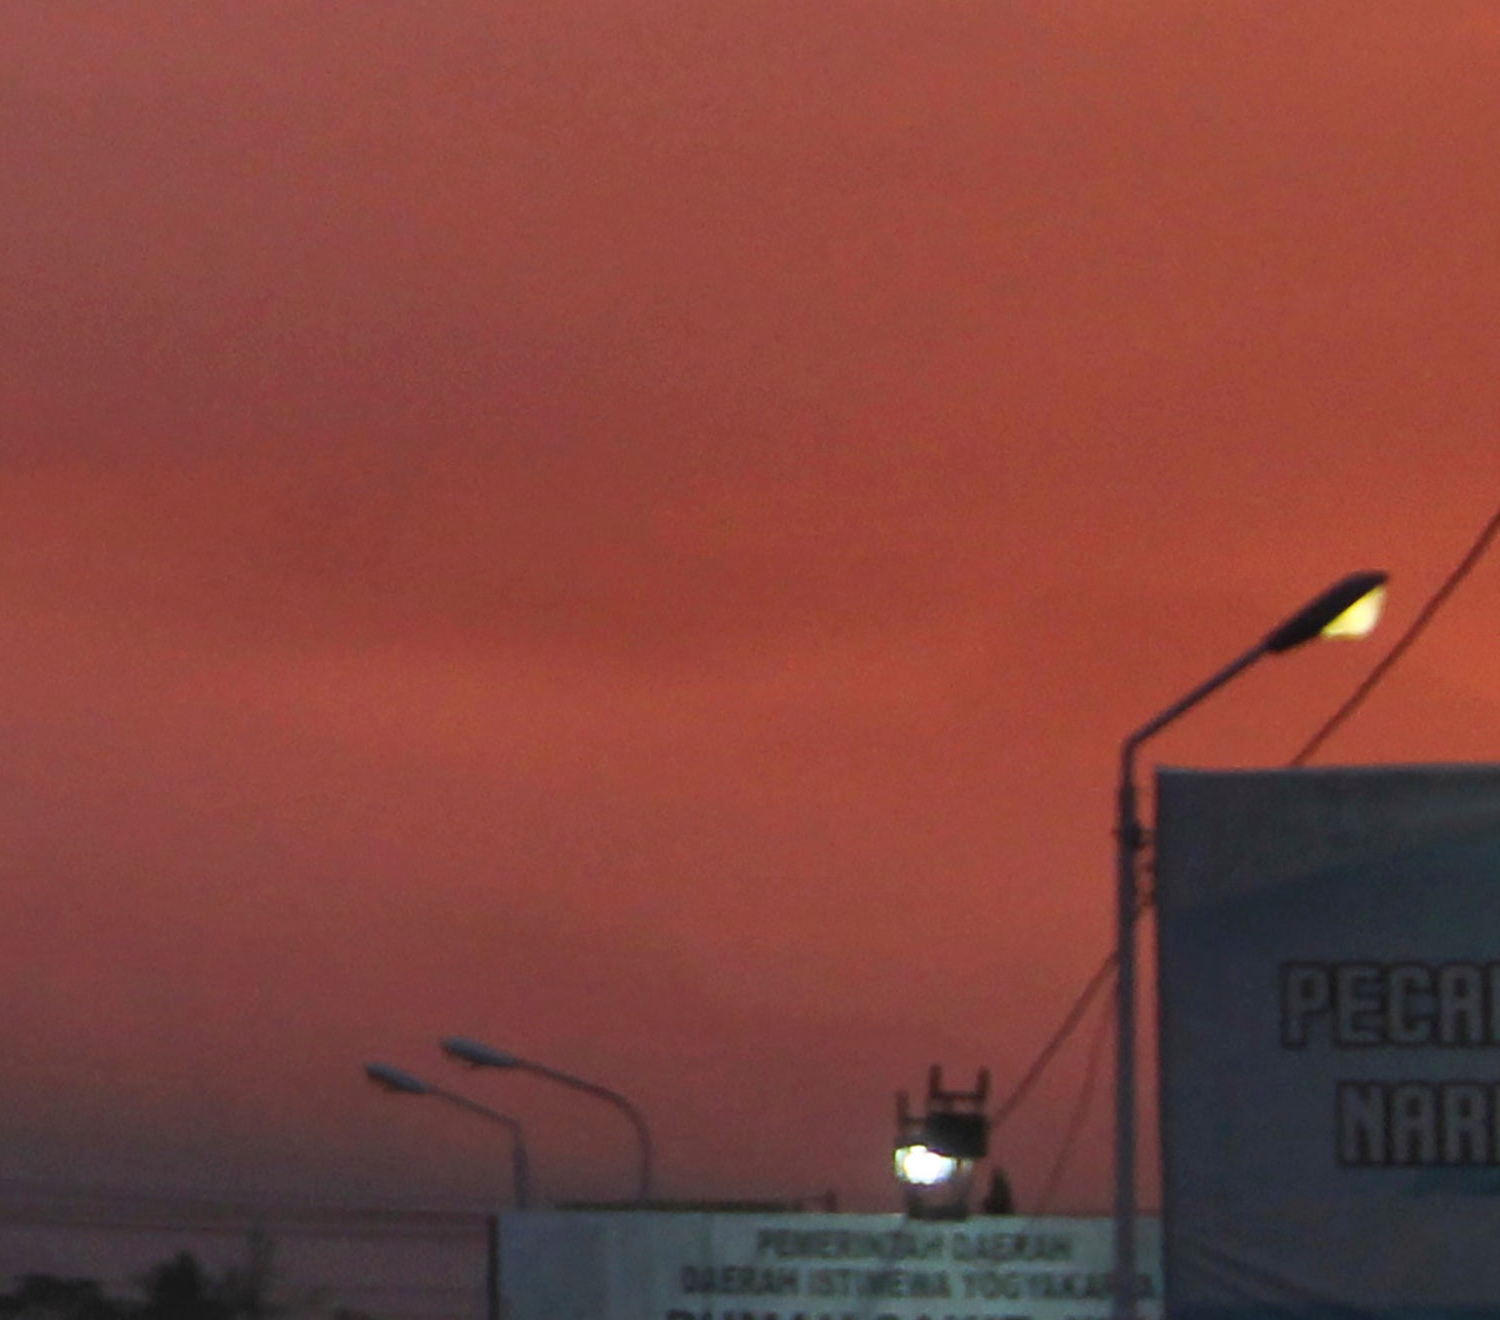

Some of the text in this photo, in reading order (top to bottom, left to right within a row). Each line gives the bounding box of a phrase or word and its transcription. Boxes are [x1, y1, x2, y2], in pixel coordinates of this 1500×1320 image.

[1280, 960, 1500, 1050] PECA
[1334, 1080, 1500, 1168] NAR
[757, 1230, 1073, 1261] PEMERINTAH DAERAH
[680, 1265, 799, 1295] DAERAH
[808, 1267, 953, 1299] ISTIMEWA
